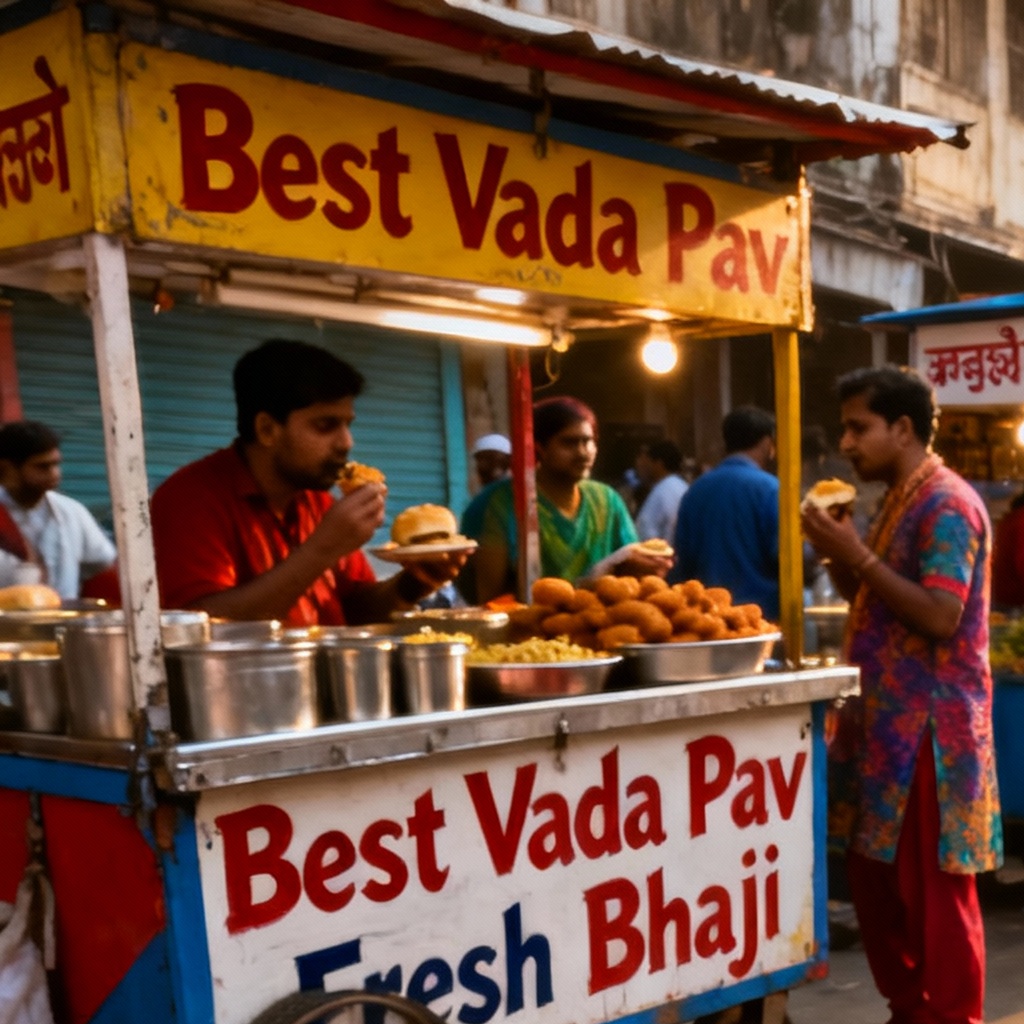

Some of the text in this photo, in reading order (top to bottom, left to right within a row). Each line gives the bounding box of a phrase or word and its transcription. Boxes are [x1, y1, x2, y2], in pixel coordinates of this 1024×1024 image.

[174, 82, 414, 239] Best
[434, 132, 642, 275] Vada
[665, 181, 789, 296] Pav
[214, 734, 808, 936] Best Vada Pav
[583, 843, 780, 996] Bhaji
